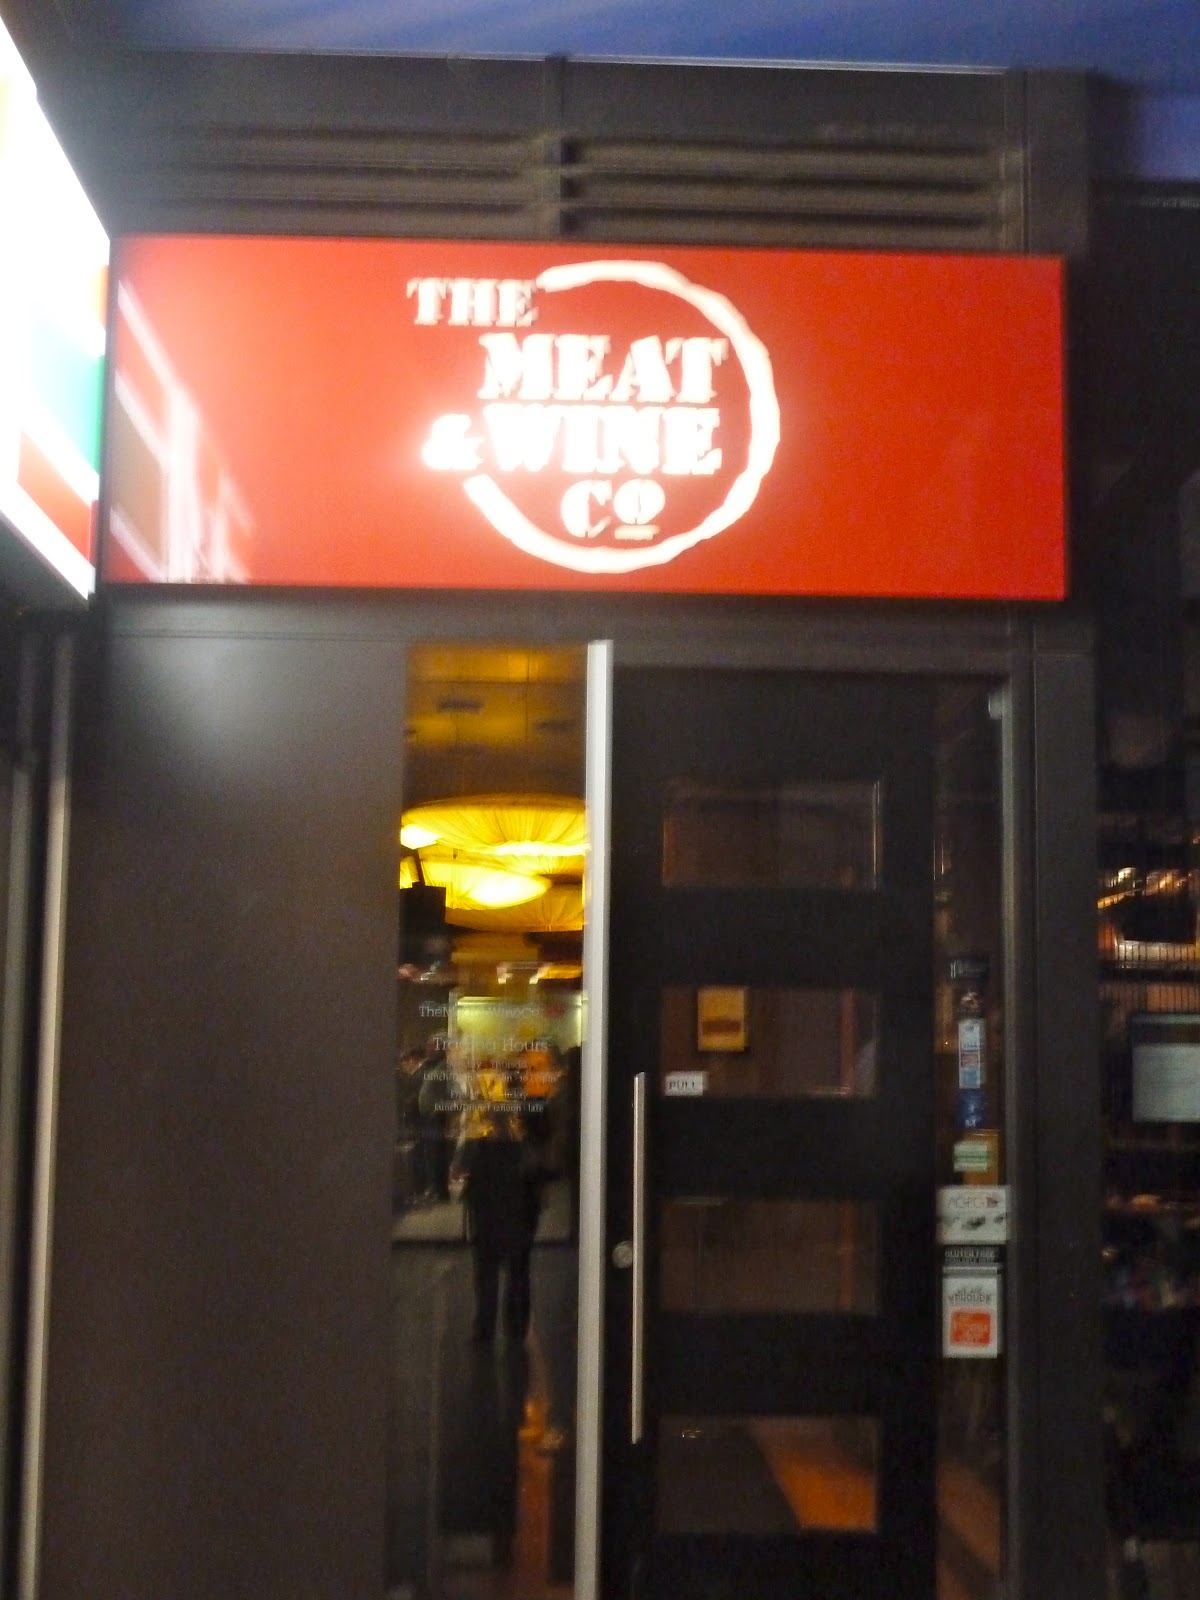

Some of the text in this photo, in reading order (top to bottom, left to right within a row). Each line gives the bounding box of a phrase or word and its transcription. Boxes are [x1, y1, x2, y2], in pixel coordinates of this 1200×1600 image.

[406, 277, 539, 327] THE
[477, 332, 728, 403] MEAT
[481, 403, 722, 475] WINE
[502, 1036, 549, 1053] Hours
[527, 1102, 545, 1113] late
